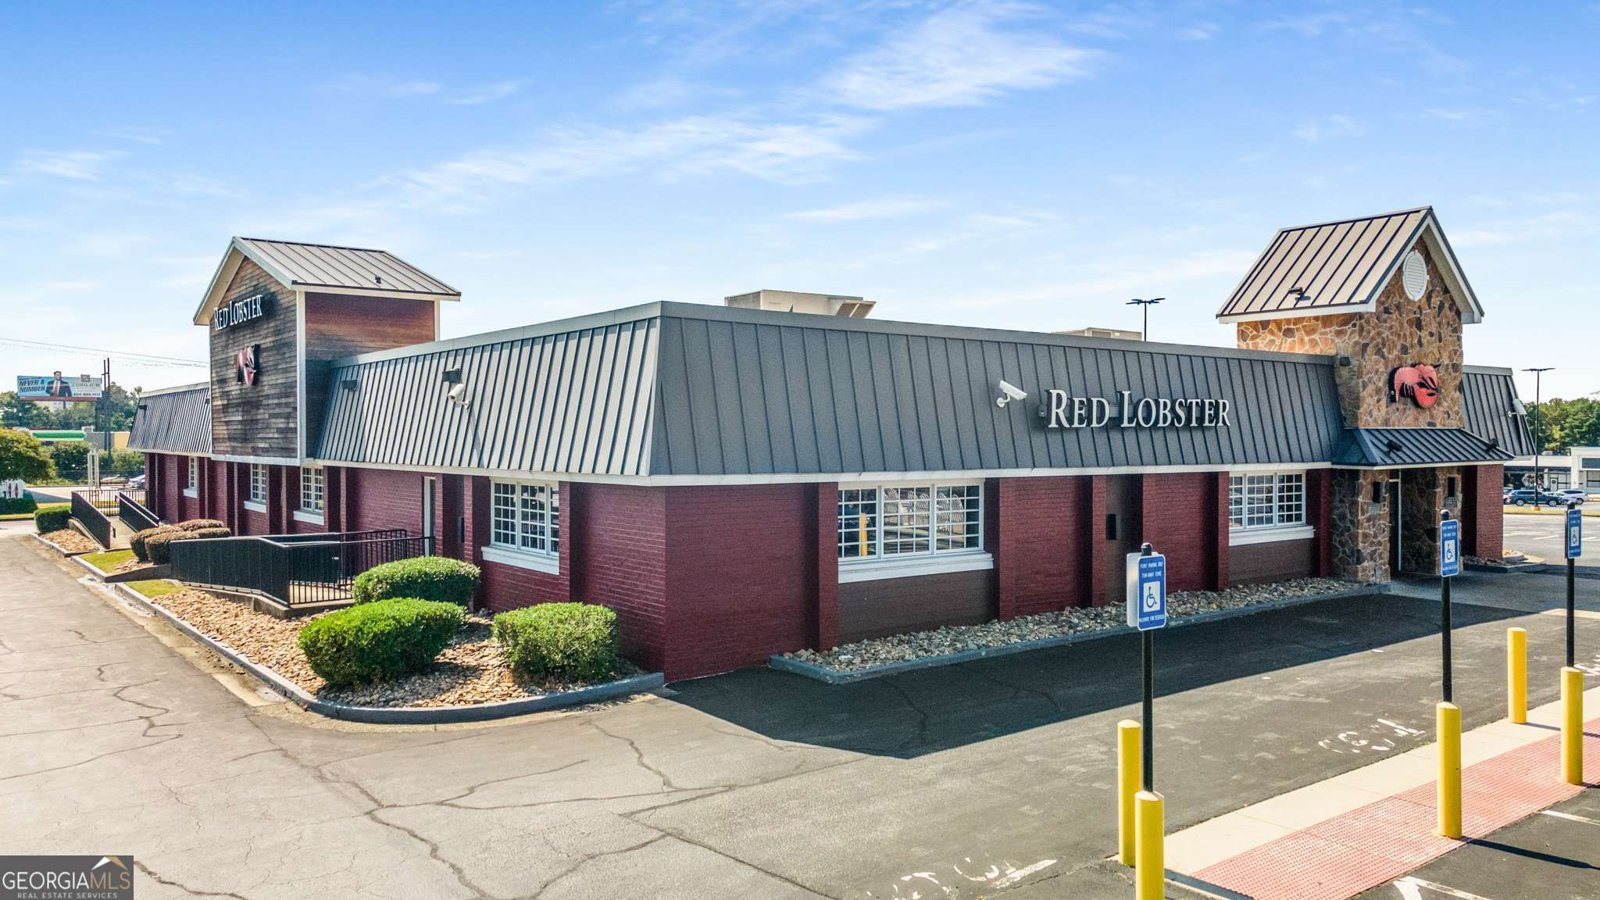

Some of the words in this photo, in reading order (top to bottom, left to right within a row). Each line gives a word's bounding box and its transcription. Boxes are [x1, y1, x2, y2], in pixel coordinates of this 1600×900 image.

[213, 307, 228, 330] RED
[229, 295, 263, 325] LOBSTER
[1048, 389, 1110, 428] RED
[1120, 390, 1231, 428] LOBSTER
